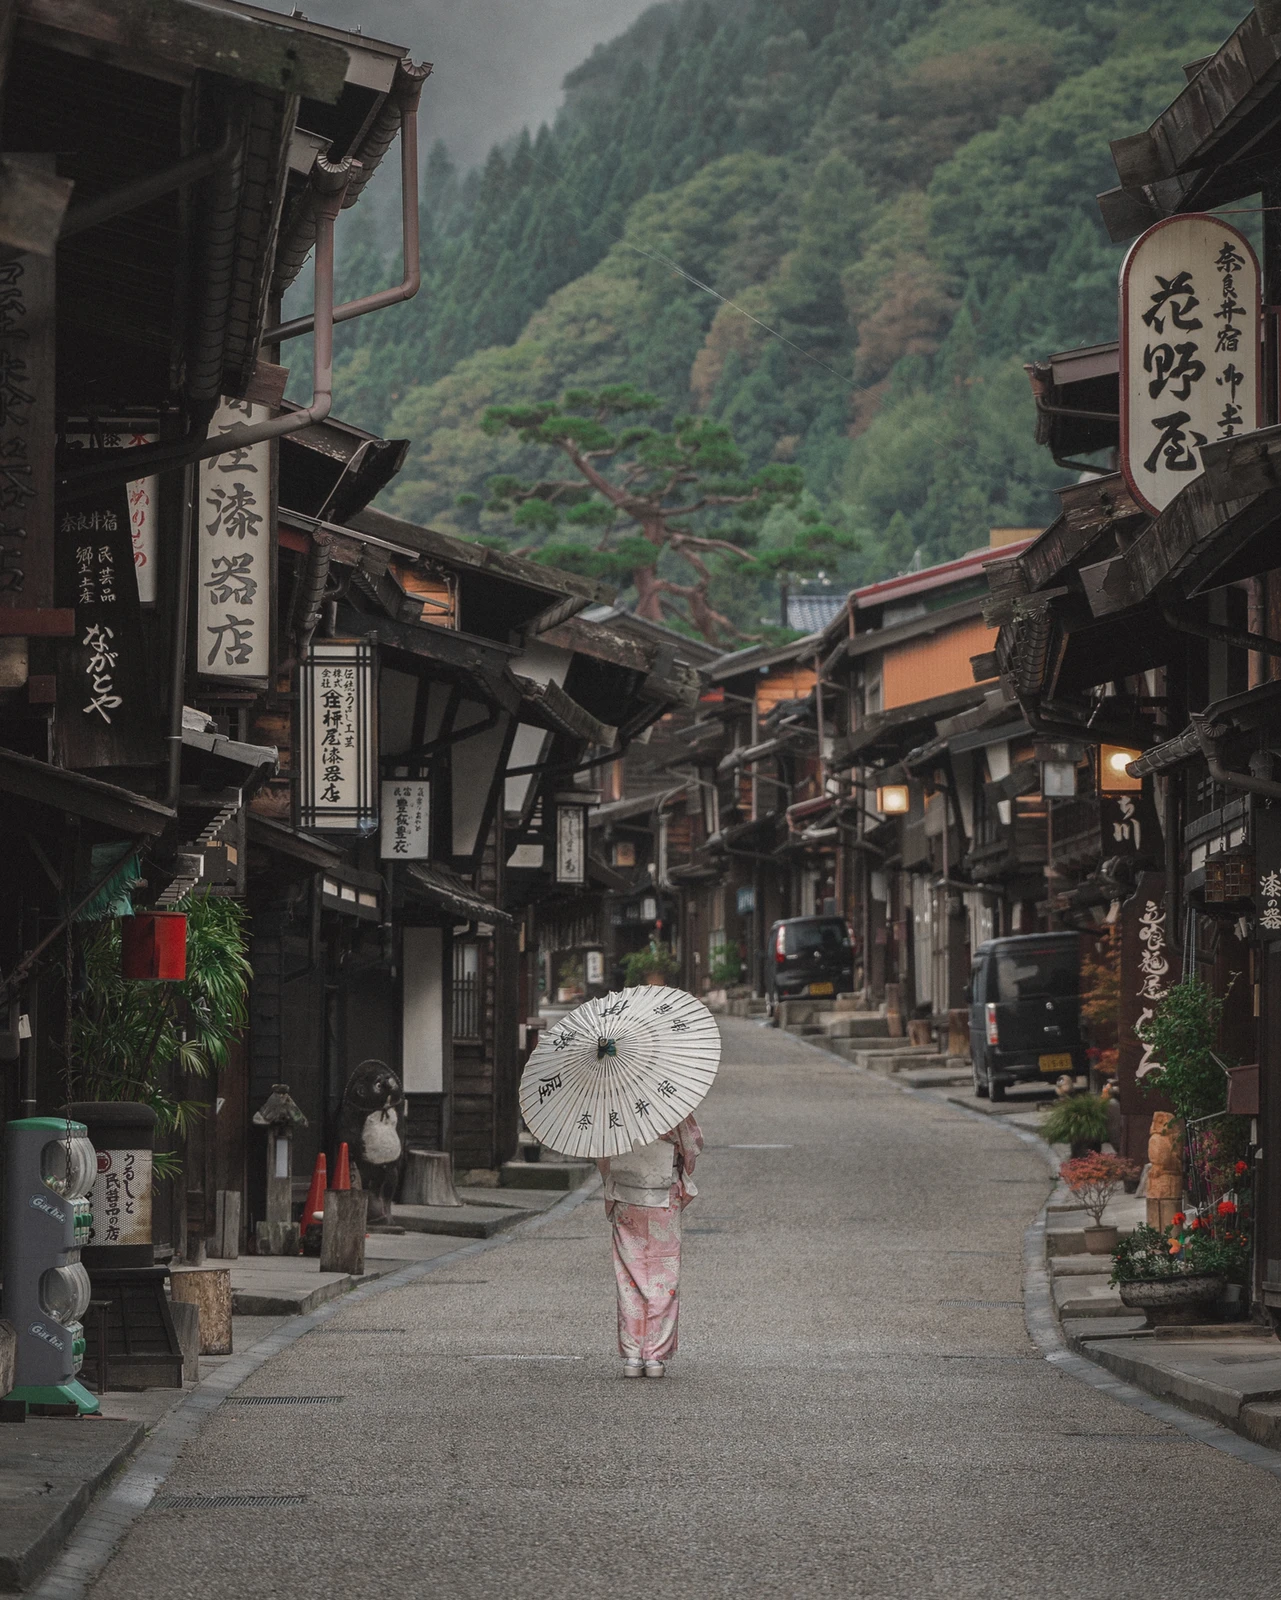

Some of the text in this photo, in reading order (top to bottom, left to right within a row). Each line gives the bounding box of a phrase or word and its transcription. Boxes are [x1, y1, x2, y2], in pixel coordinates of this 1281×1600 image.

[1213, 241, 1247, 353] 奈良井宿
[1141, 271, 1209, 474] 花野屋
[60, 510, 118, 533] 奈良井宿
[75, 546, 96, 605] 郷土土産
[97, 546, 118, 603] 民芸品
[82, 622, 124, 724] ながとや
[1259, 870, 1281, 930] 漆の器
[576, 1080, 677, 1131] 奈良井宿
[122, 1153, 136, 1214] うるしと
